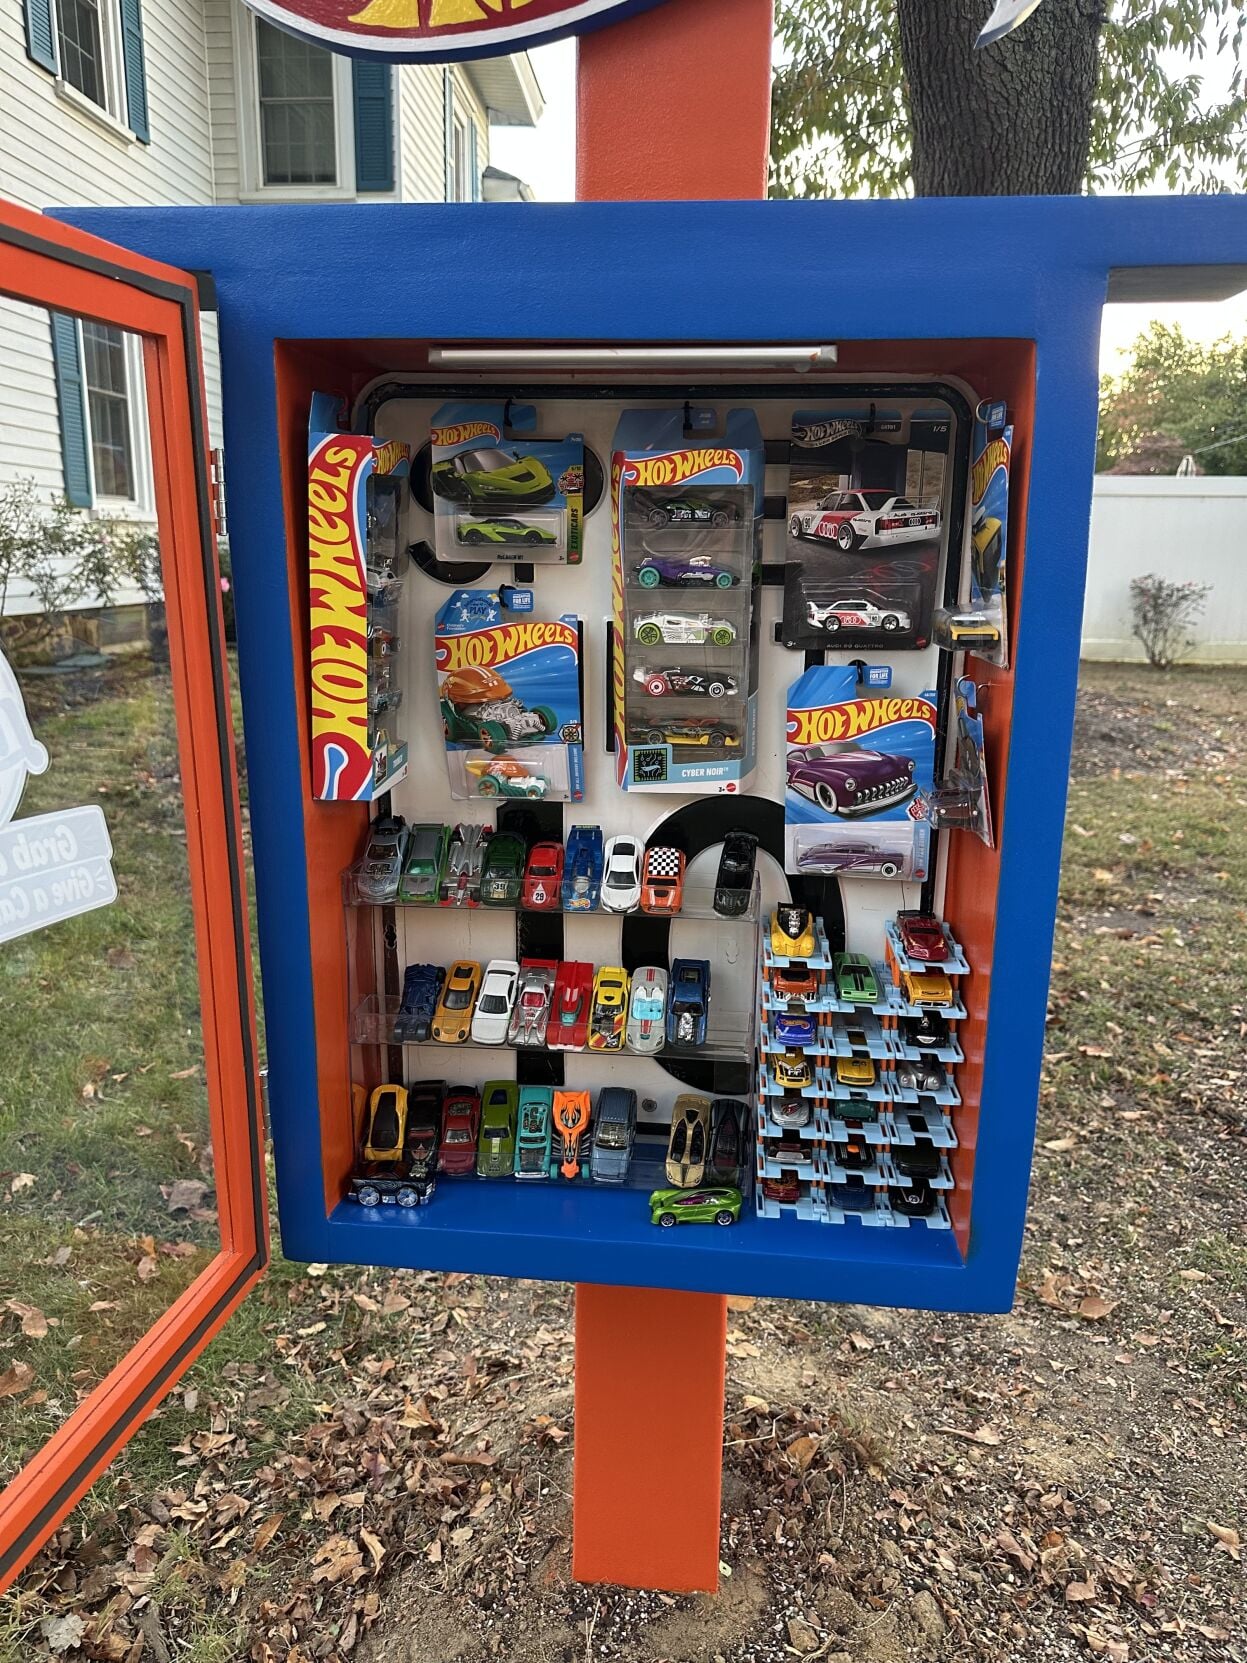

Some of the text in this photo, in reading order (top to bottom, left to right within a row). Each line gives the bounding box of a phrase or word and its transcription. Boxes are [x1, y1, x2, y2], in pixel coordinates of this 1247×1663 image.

[436, 422, 496, 446] HOT WHEELS
[804, 425, 826, 441] HOT
[635, 449, 736, 486] HOT WHEELS
[570, 507, 579, 550] EXOTICARS
[308, 446, 370, 759] HOT WHEELS
[442, 624, 573, 670] HOT WHEELS
[793, 710, 849, 744] HOT
[846, 698, 932, 739] WHEELS
[681, 768, 705, 777] CYBER
